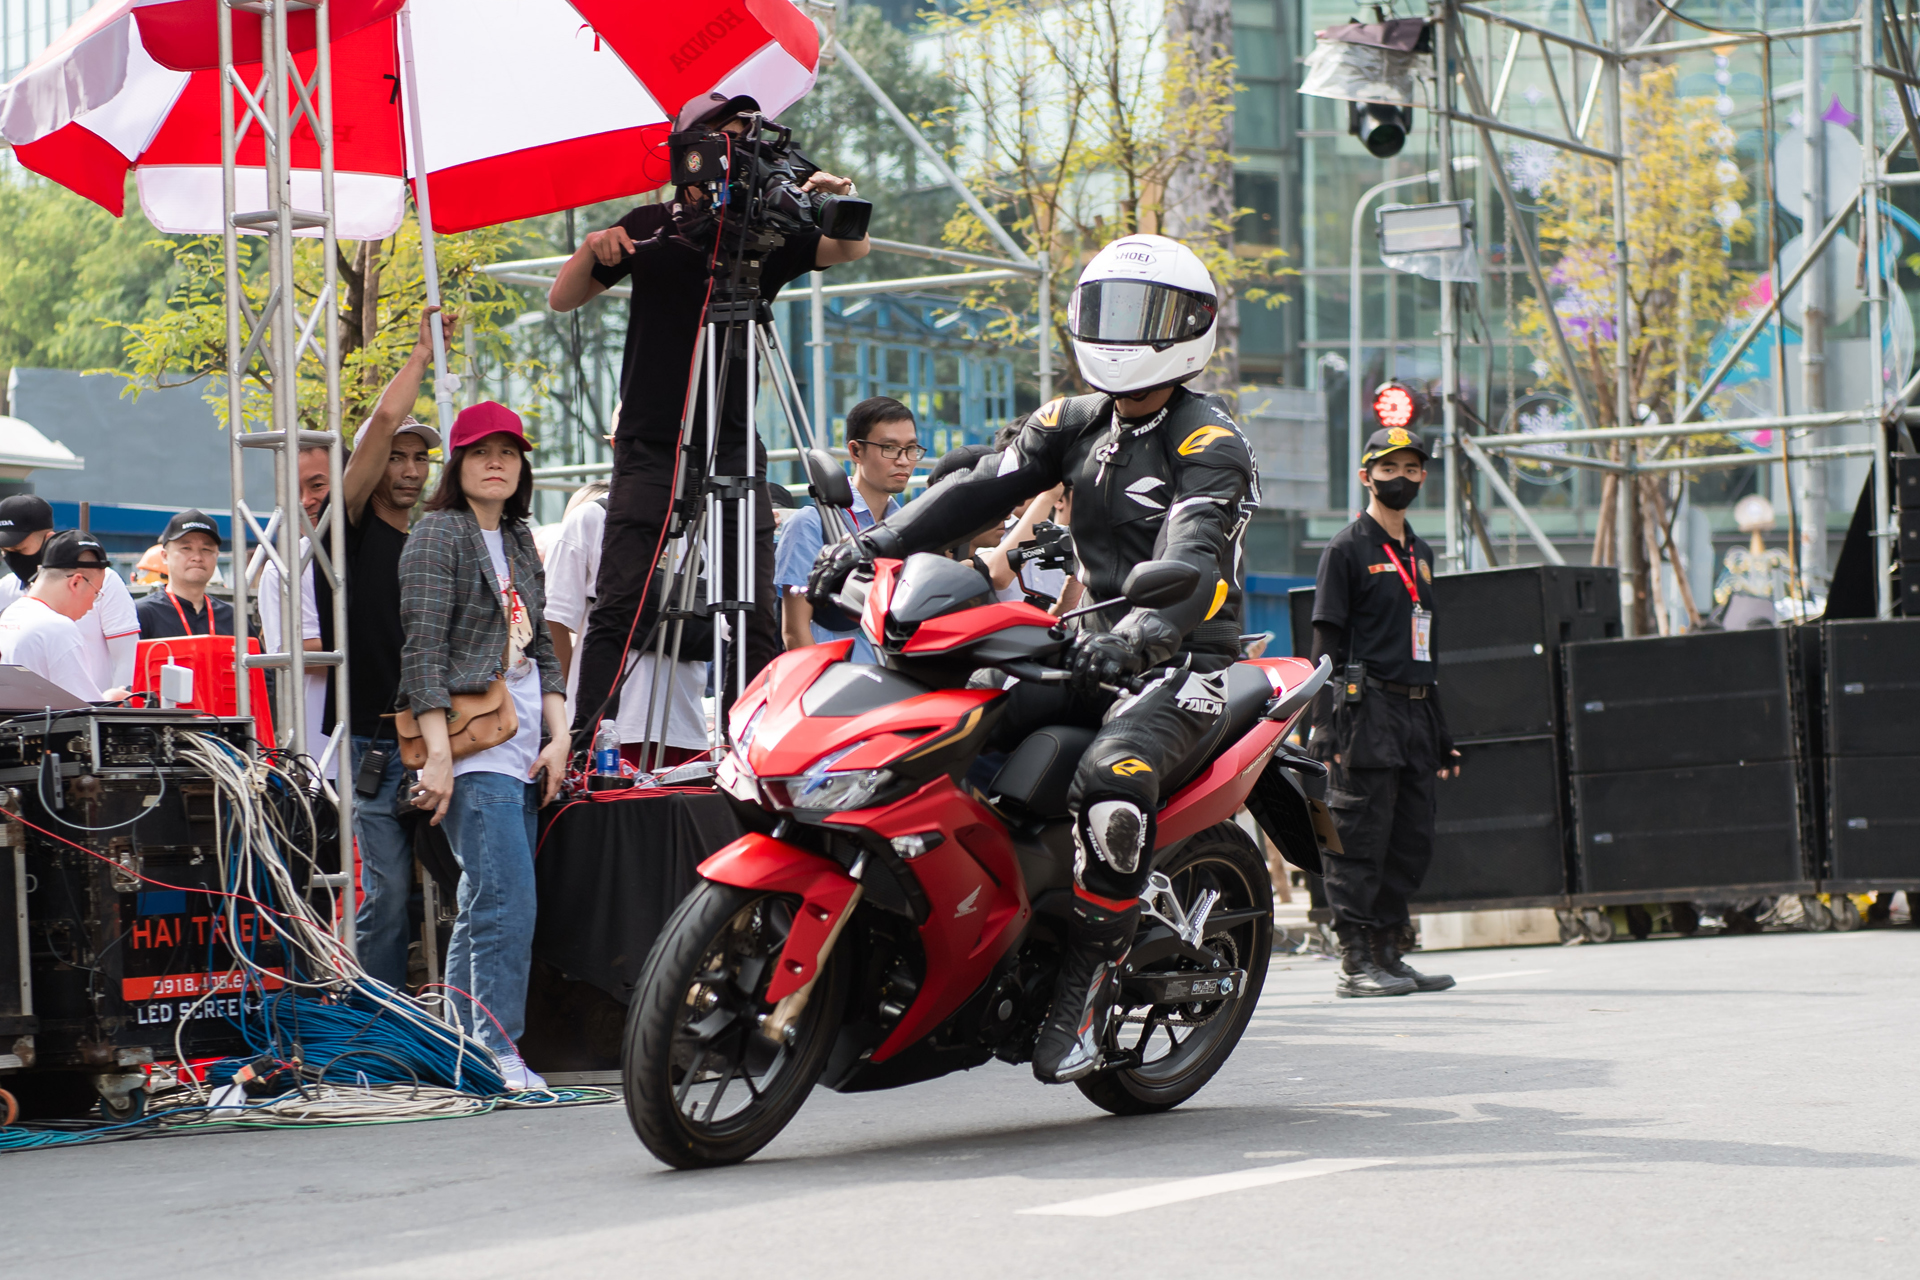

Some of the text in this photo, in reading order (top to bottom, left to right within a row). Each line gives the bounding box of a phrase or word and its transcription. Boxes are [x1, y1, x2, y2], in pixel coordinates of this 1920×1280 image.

[1132, 407, 1169, 437] TAICHI
[1021, 547, 1046, 559] RONIN
[1177, 698, 1223, 716] TAICHI
[1086, 826, 1106, 861] TAICHI
[132, 913, 275, 949] HAI TREU
[137, 1004, 173, 1025] LED
